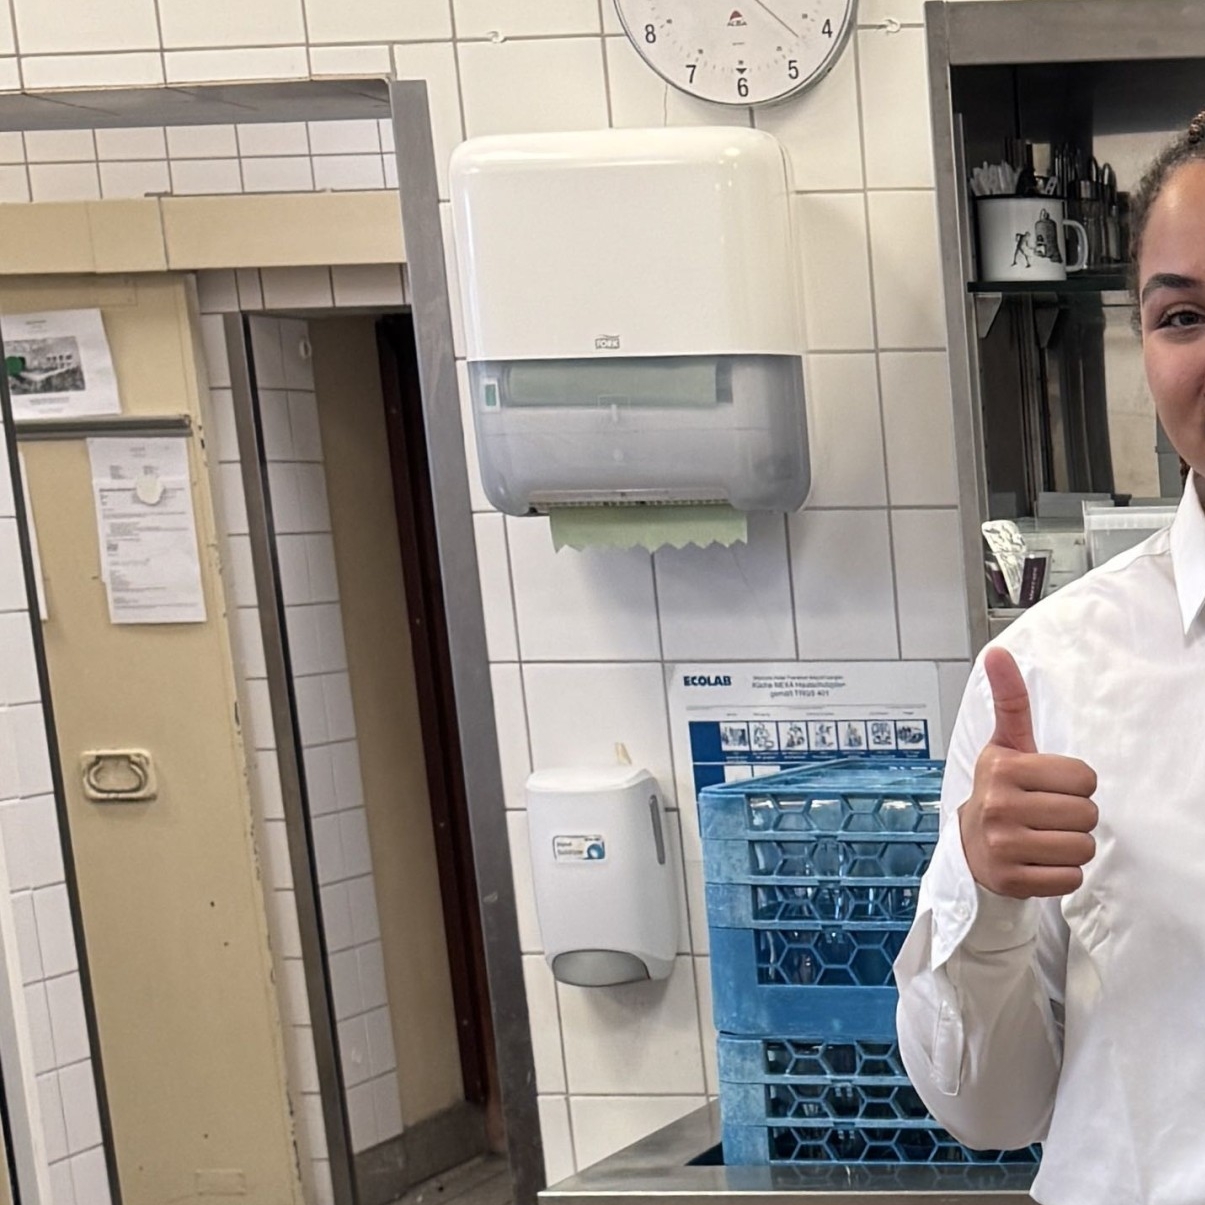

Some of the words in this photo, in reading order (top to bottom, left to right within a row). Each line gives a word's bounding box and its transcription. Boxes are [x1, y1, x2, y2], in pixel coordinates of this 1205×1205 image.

[645, 24, 656, 43] 8
[822, 19, 833, 38] 4
[685, 65, 697, 83] 7
[788, 60, 799, 79] 5
[737, 78, 749, 97] 6
[596, 339, 619, 348] TORK
[683, 676, 732, 686] ECOLAB
